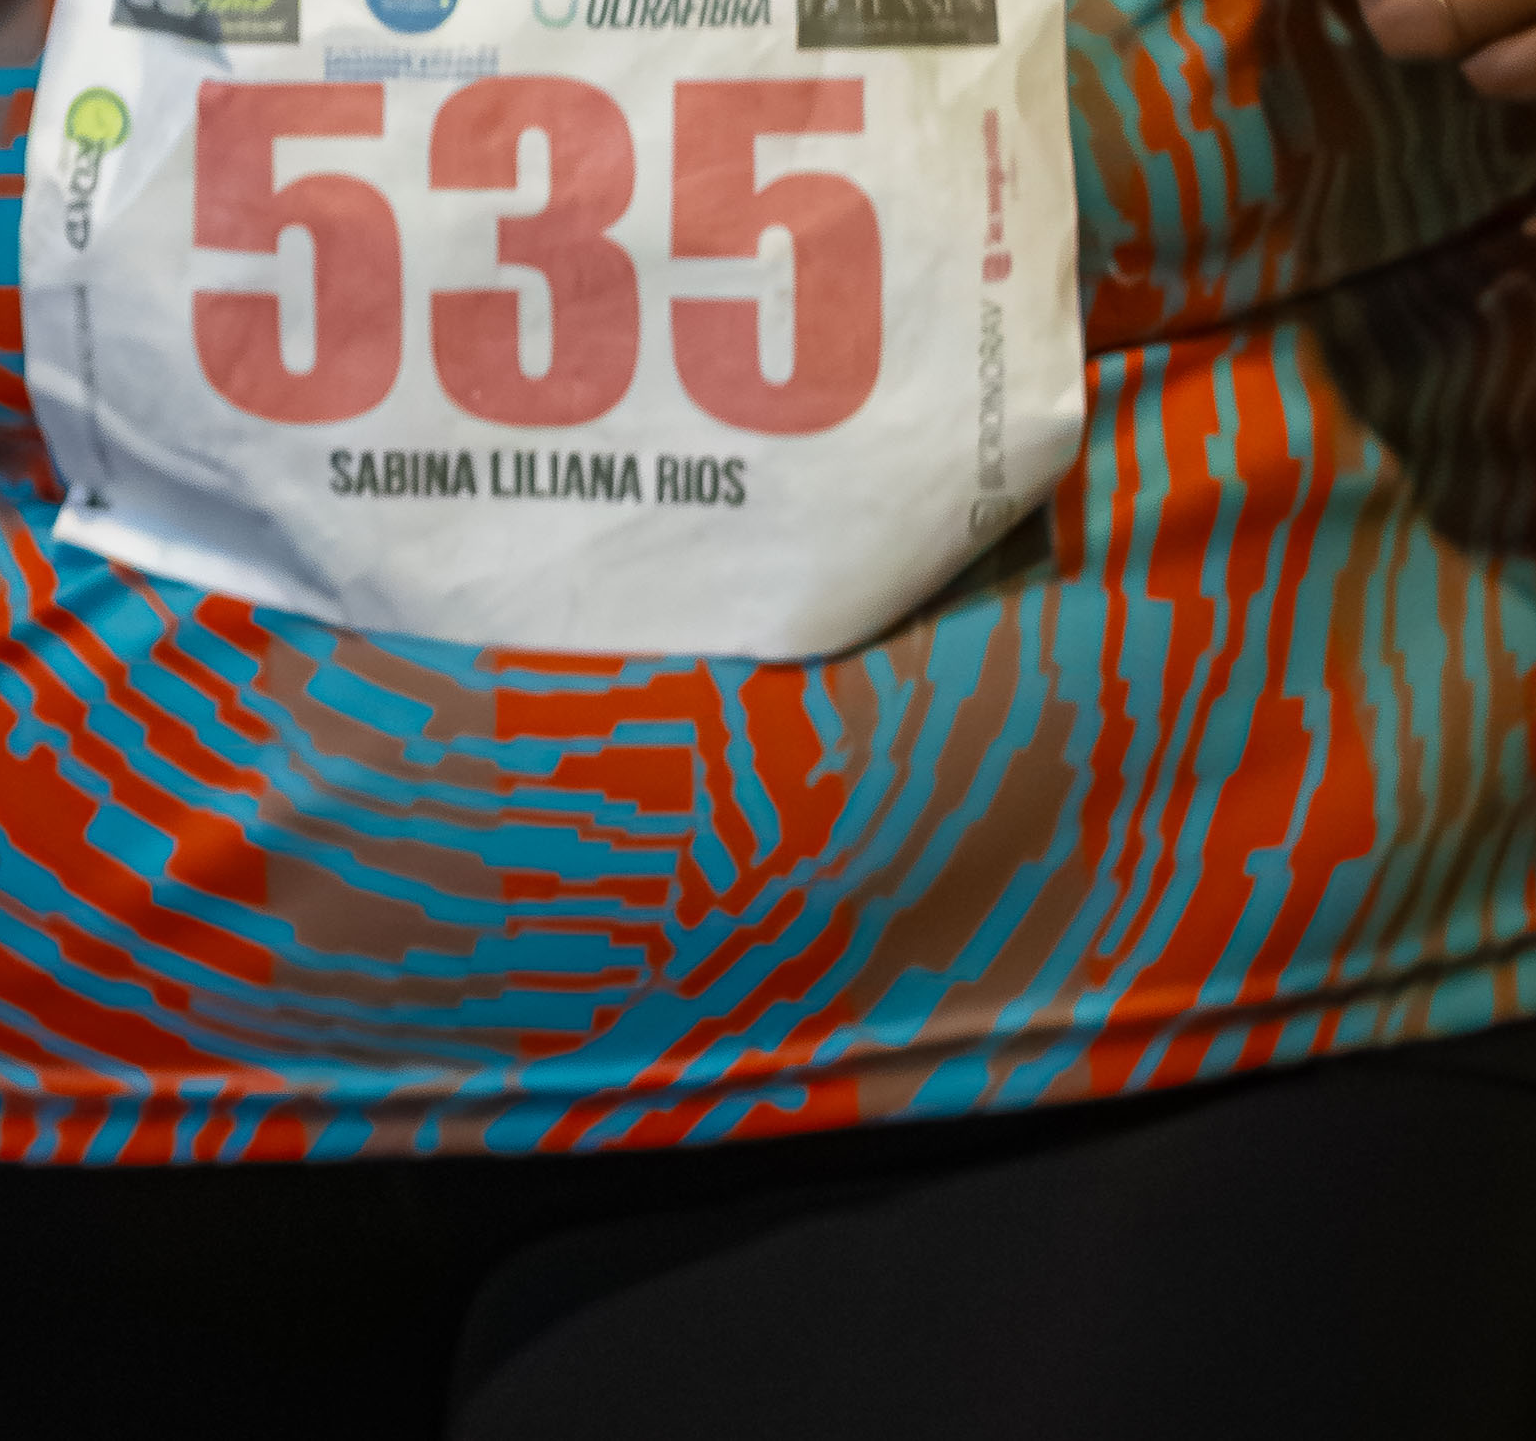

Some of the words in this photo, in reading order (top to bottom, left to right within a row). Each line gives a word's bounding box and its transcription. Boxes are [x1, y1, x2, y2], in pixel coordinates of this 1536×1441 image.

[192, 74, 884, 436] 535
[329, 447, 477, 498] SABINA
[489, 449, 643, 503] LILIANA
[655, 453, 747, 507] RIOS
